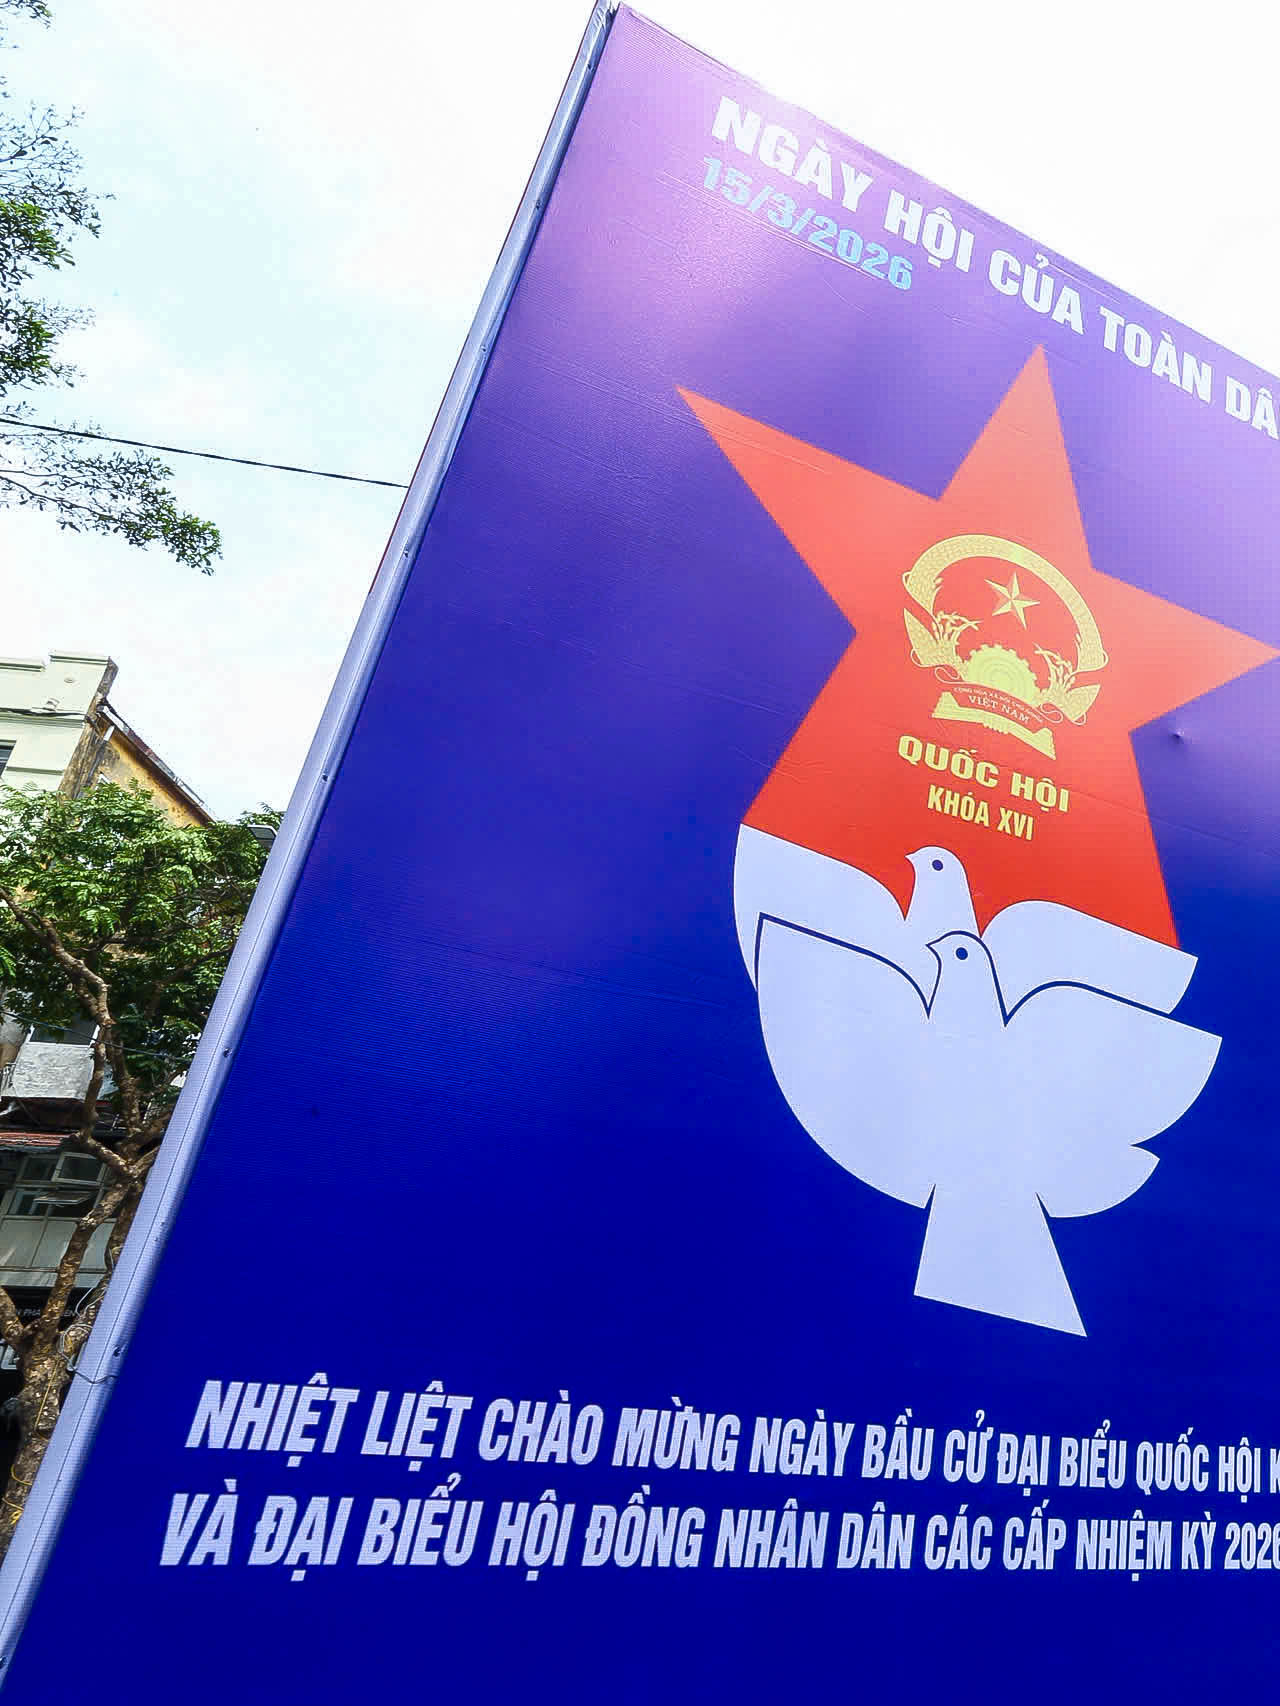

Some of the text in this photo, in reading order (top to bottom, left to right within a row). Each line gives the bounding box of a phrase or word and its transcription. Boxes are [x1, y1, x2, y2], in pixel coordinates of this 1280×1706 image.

[703, 156, 913, 291] 15/3/2026
[711, 95, 874, 213] NGÀY
[884, 189, 975, 273] HỘI
[988, 250, 1085, 336] CỦA
[1098, 304, 1212, 403] TOÀN
[1002, 704, 1029, 723] NAM
[899, 736, 1068, 812] QUỐC HỘI
[928, 785, 1033, 840] KHÓA XVI
[185, 1373, 360, 1467] NHIỆT
[361, 1381, 473, 1471] LIỆT
[479, 1390, 603, 1464] CHÀO
[612, 1397, 740, 1471] MỪNG
[749, 1409, 854, 1476] NGÀY
[862, 1408, 934, 1480] BẦU
[944, 1410, 993, 1483] CỬ
[997, 1433, 1050, 1496] ĐẠI
[1059, 1420, 1126, 1488] BIỂU
[1136, 1428, 1209, 1495] QUỐC
[1219, 1437, 1260, 1502] HỘI
[160, 1479, 238, 1565] VÀ
[248, 1496, 353, 1581] ĐẠI
[358, 1473, 483, 1566] BIỂU
[488, 1490, 575, 1580] HỘI
[582, 1485, 705, 1567] ĐỒNG
[714, 1499, 829, 1568] NHÂN
[837, 1502, 915, 1569] DÂN
[925, 1505, 992, 1569] CÁC
[1003, 1499, 1066, 1570] CẤP
[1076, 1510, 1172, 1581] NHIỆM
[1182, 1512, 1216, 1569] KỲ
